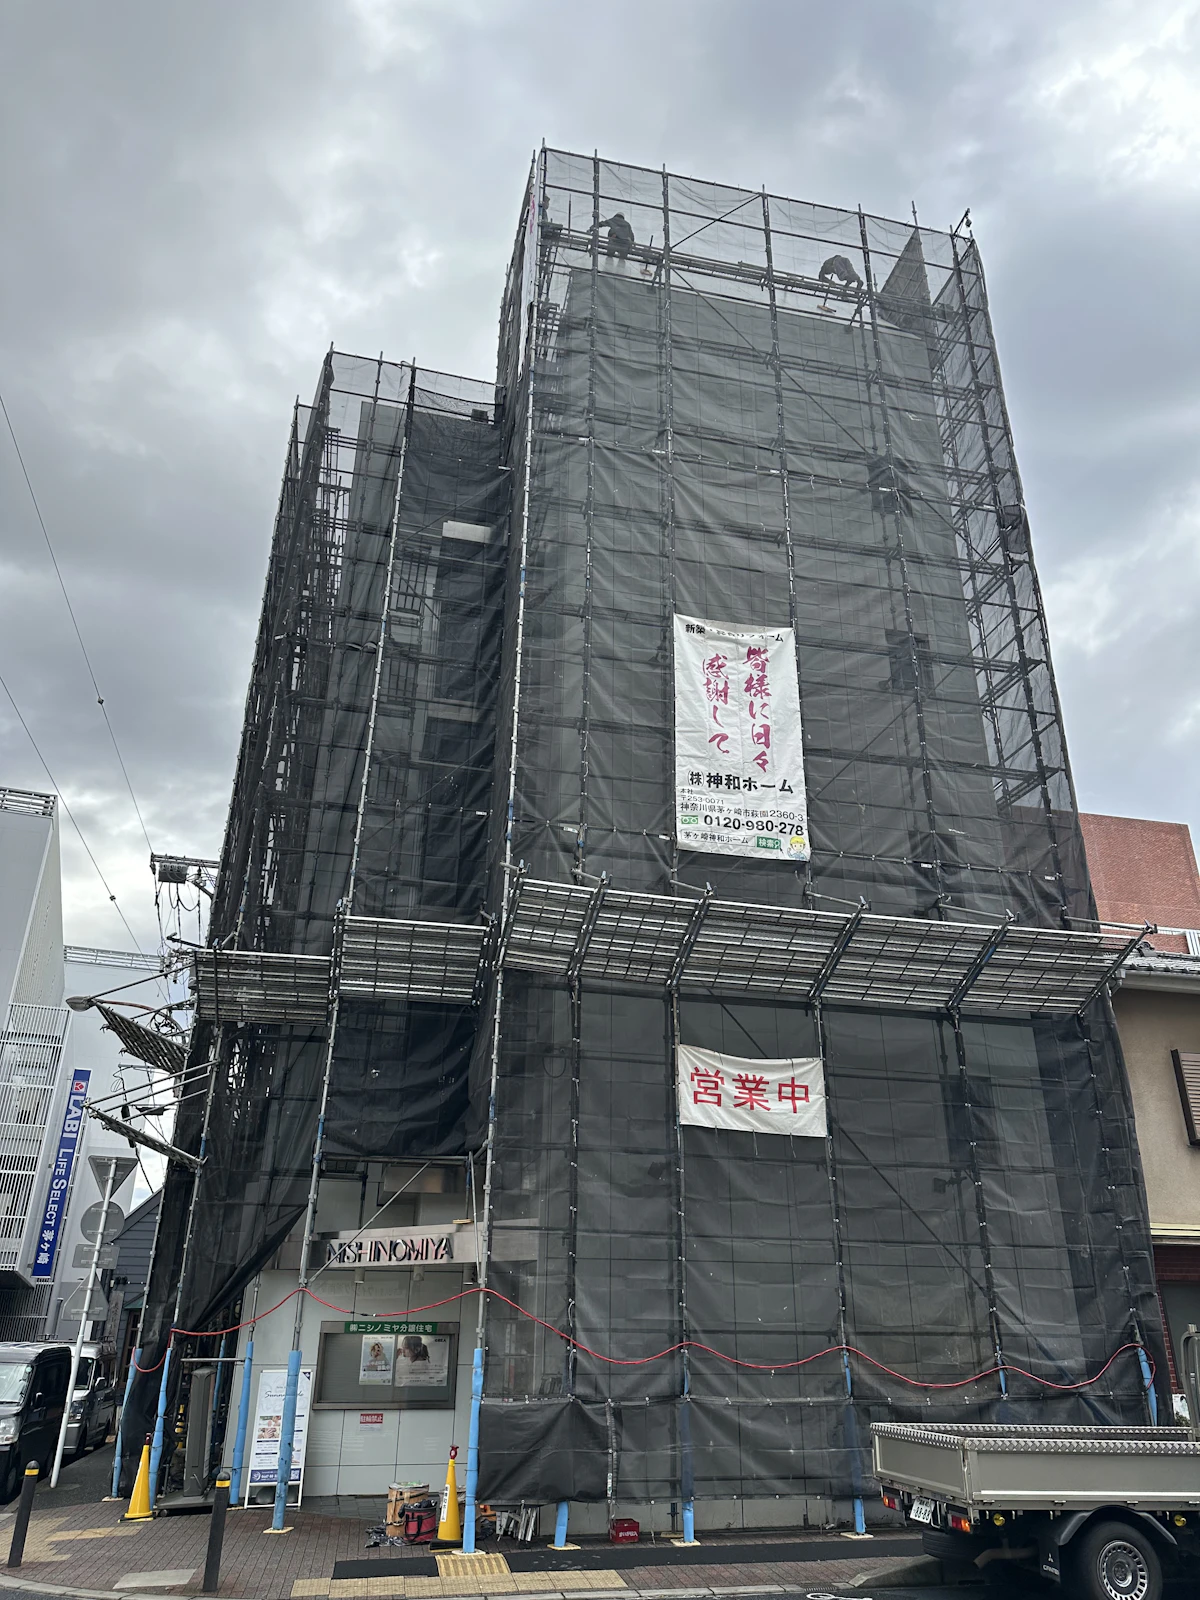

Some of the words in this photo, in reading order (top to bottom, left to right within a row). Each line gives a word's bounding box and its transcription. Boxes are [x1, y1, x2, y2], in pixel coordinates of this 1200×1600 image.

[702, 653, 730, 754] 感謝して
[742, 646, 772, 773] 皆様に日々
[703, 814, 804, 836] 0120-980-278
[690, 1066, 810, 1114] 営業中
[62, 1095, 84, 1138] LABI
[55, 1148, 74, 1176] LIFE
[44, 1178, 68, 1227] SELECT
[326, 1237, 454, 1264] NISHINOMIYA
